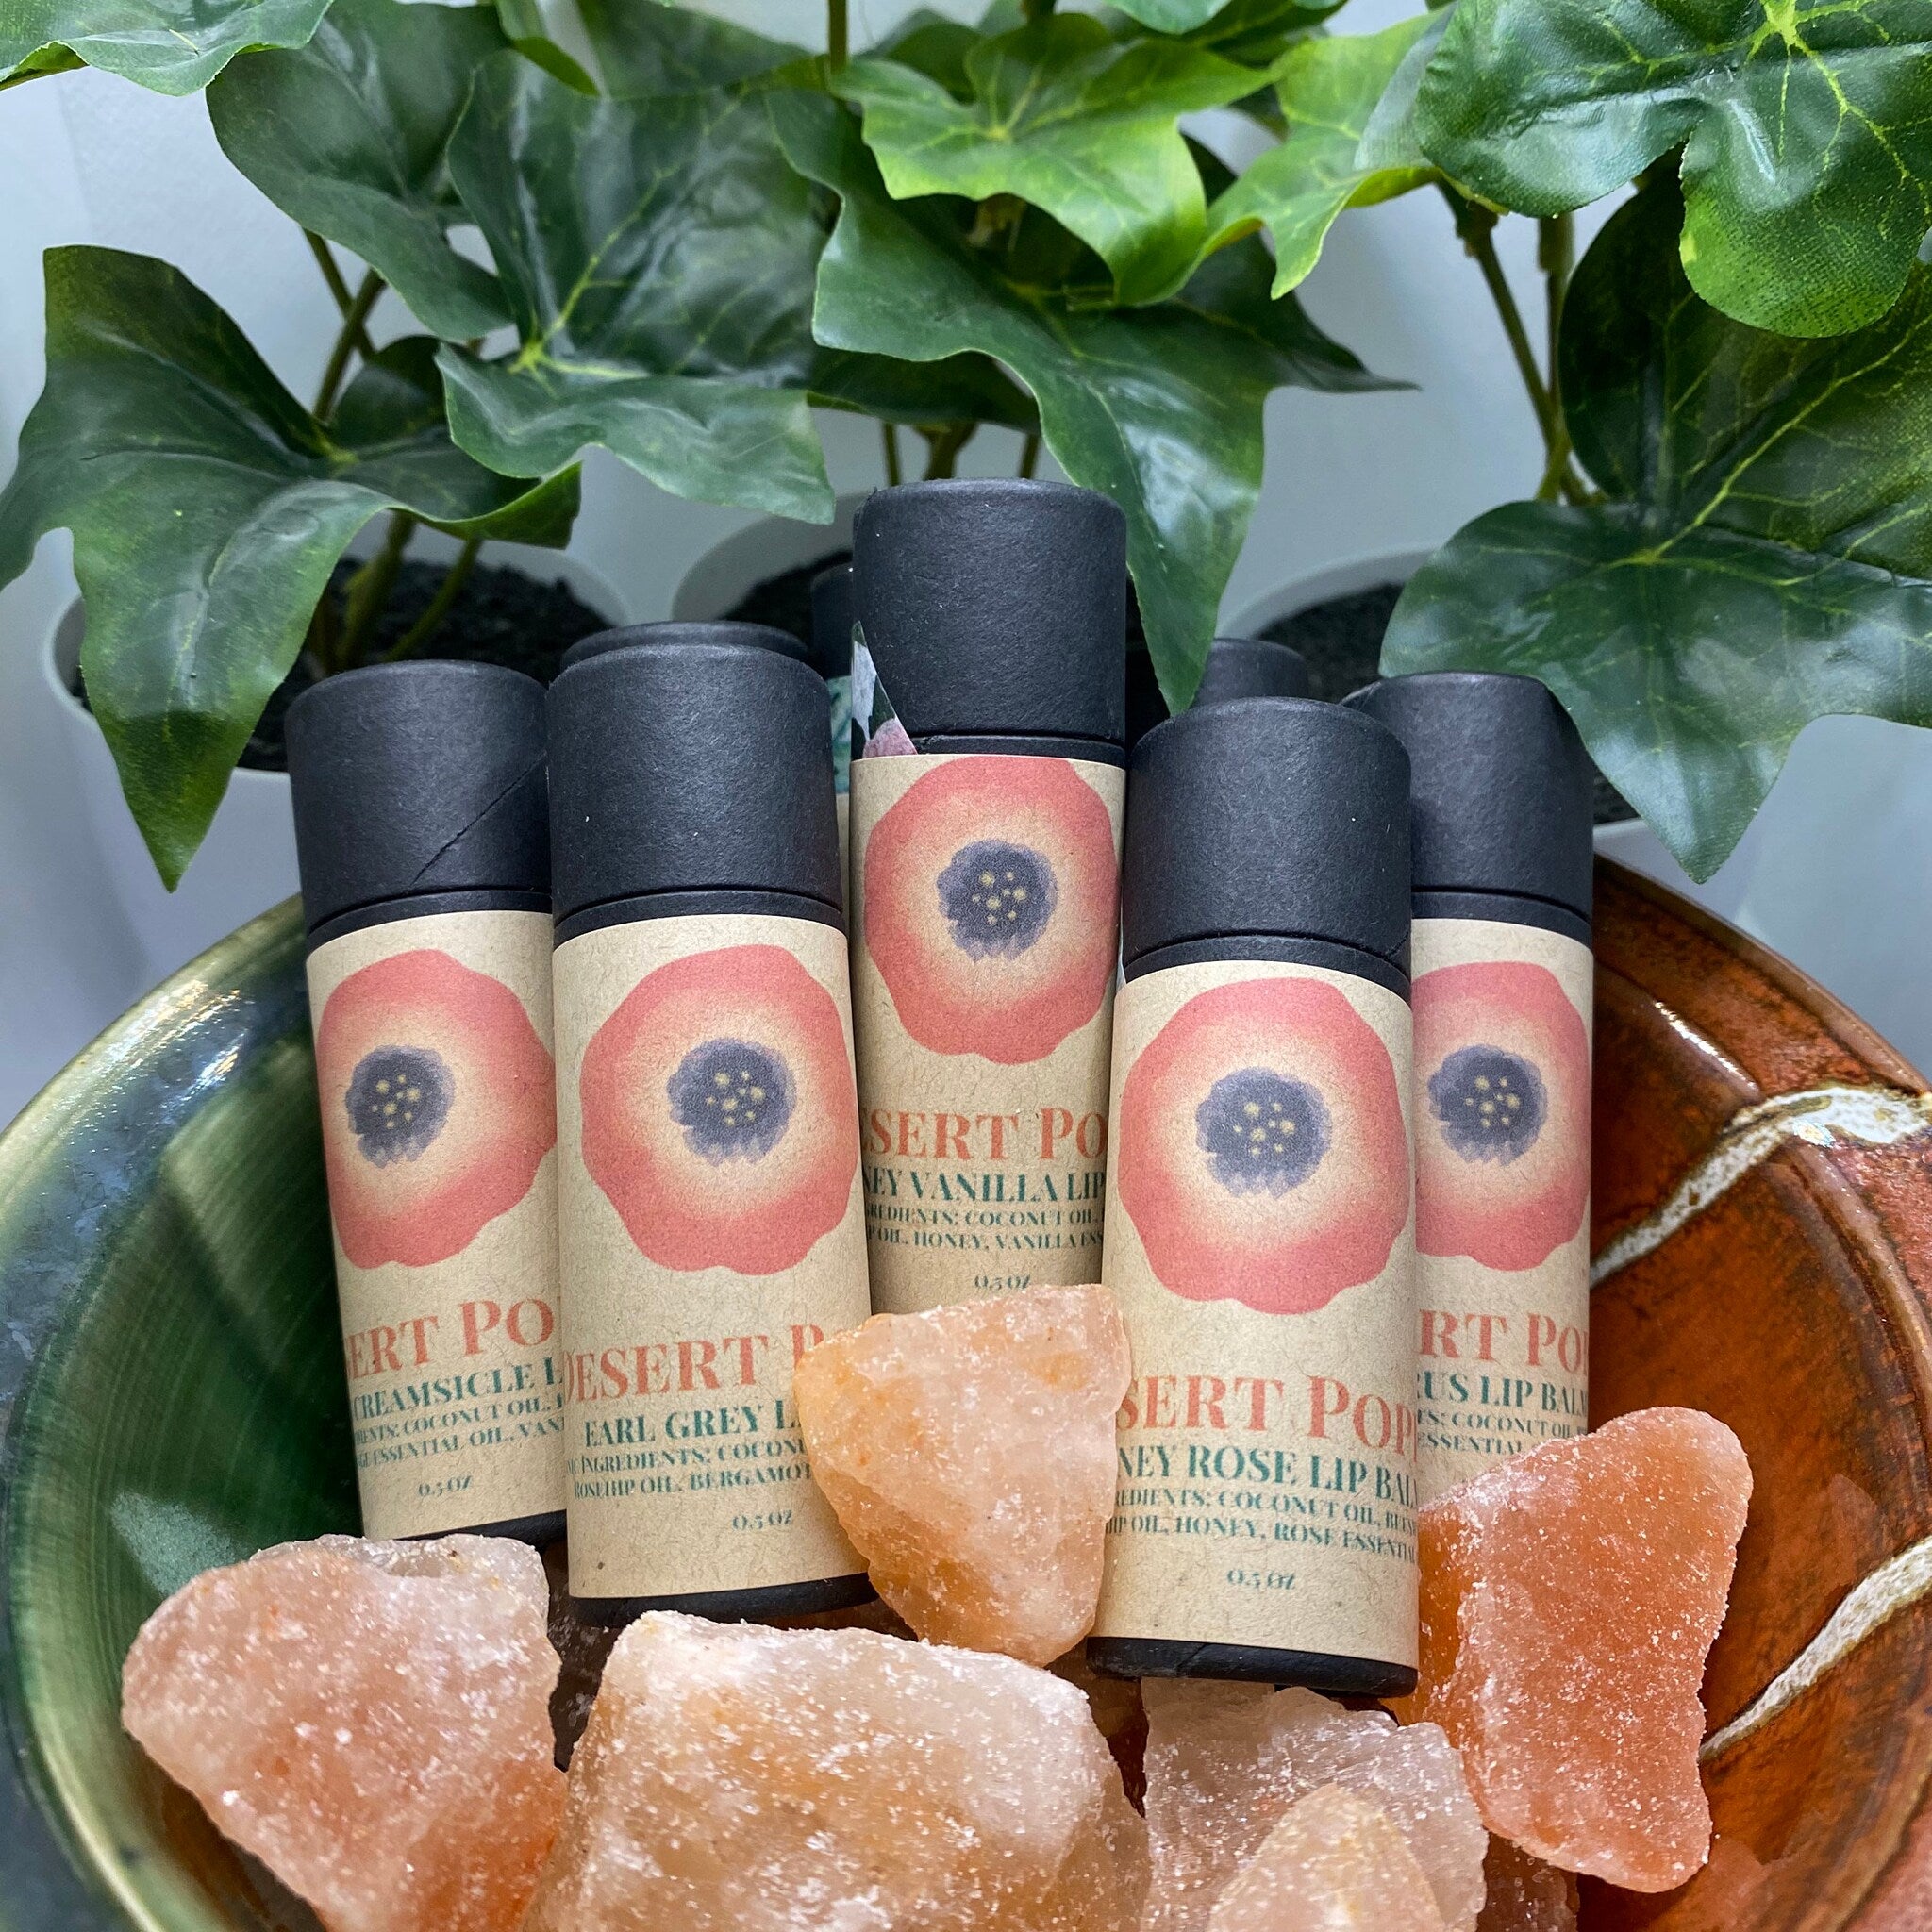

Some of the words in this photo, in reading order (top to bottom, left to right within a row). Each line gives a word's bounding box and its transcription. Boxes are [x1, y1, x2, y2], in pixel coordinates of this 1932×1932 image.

[910, 1171, 1058, 1202] VANILLA
[1067, 1171, 1106, 1201] LIP
[964, 1209, 1062, 1227] COCONUT
[913, 1231, 991, 1251] HONEY,
[995, 1233, 1077, 1251] VANILLA
[1417, 1370, 1470, 1404] US
[1480, 1375, 1534, 1407] LIP
[403, 1402, 504, 1438] COCONUT
[585, 1414, 657, 1448] EARL
[664, 1404, 764, 1440] GREY
[1307, 1375, 1417, 1463] POP
[1451, 1412, 1548, 1438] COCONUT
[580, 1445, 711, 1474] INGREDIENTS:
[1188, 1444, 1297, 1485] ROSE
[1309, 1455, 1368, 1494] LIP
[574, 1478, 636, 1500] ROSEHIP
[732, 1513, 763, 1531] 0.5
[767, 1509, 793, 1526] OZ
[1218, 1491, 1343, 1520] COCONUT
[1343, 1503, 1382, 1527] OIL,
[1132, 1515, 1170, 1535] OIL,
[1176, 1516, 1267, 1540] HONEY,
[1274, 1522, 1332, 1547] ROSE
[1266, 1570, 1296, 1591] OZ
